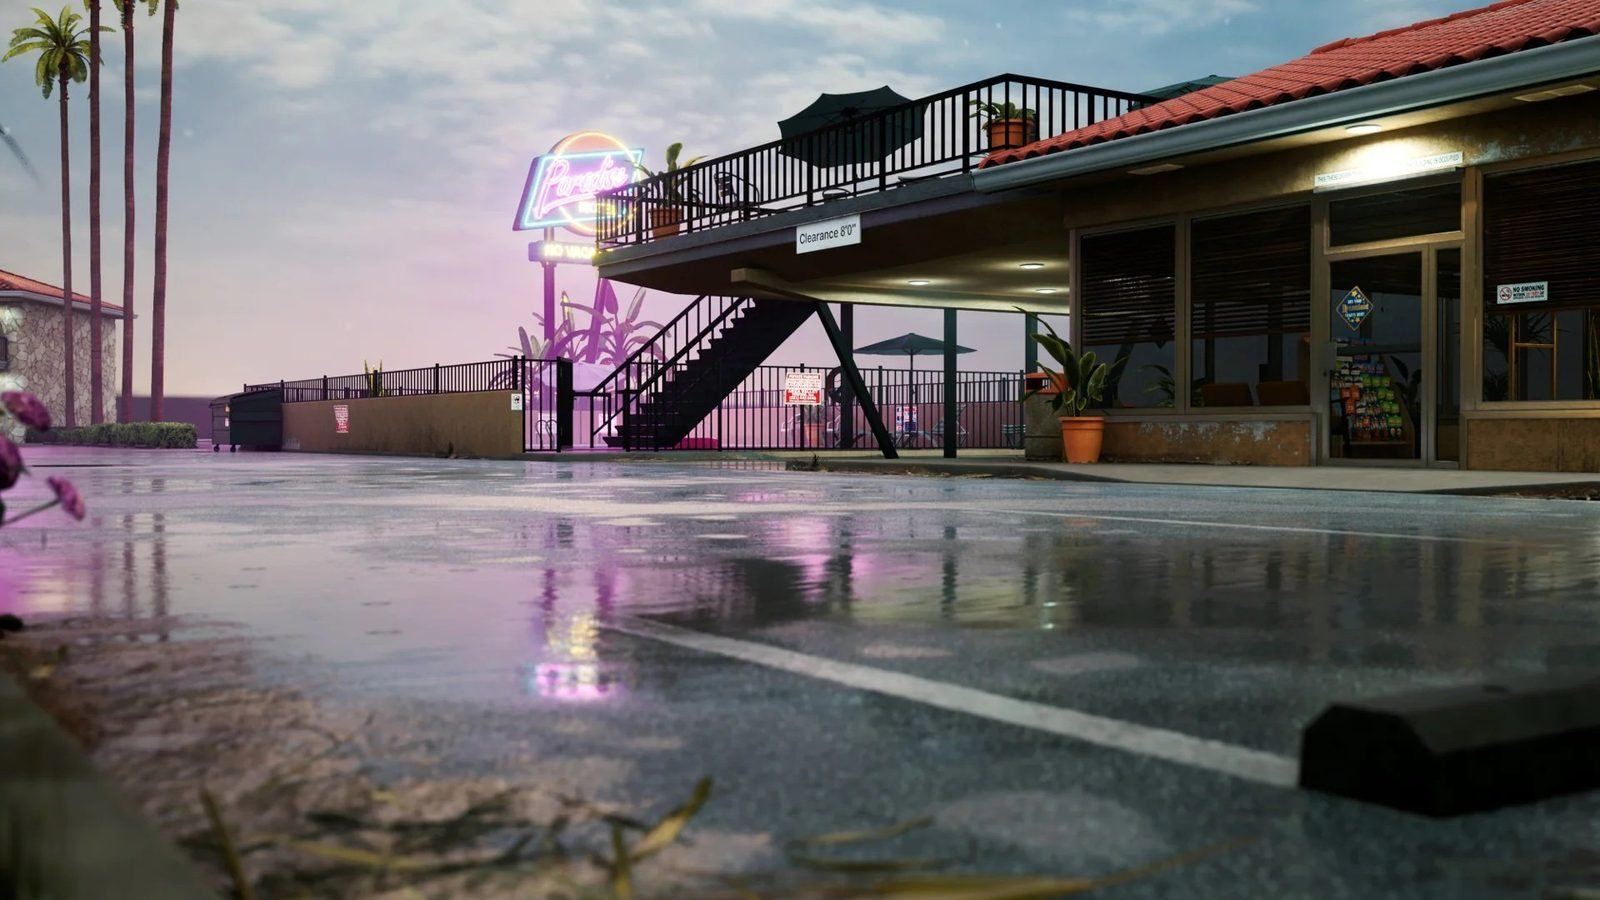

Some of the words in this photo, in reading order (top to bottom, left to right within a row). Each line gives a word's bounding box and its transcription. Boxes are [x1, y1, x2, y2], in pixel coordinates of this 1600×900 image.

[534, 156, 628, 219] Paradise
[799, 229, 839, 244] Clearance
[544, 243, 563, 256] NO
